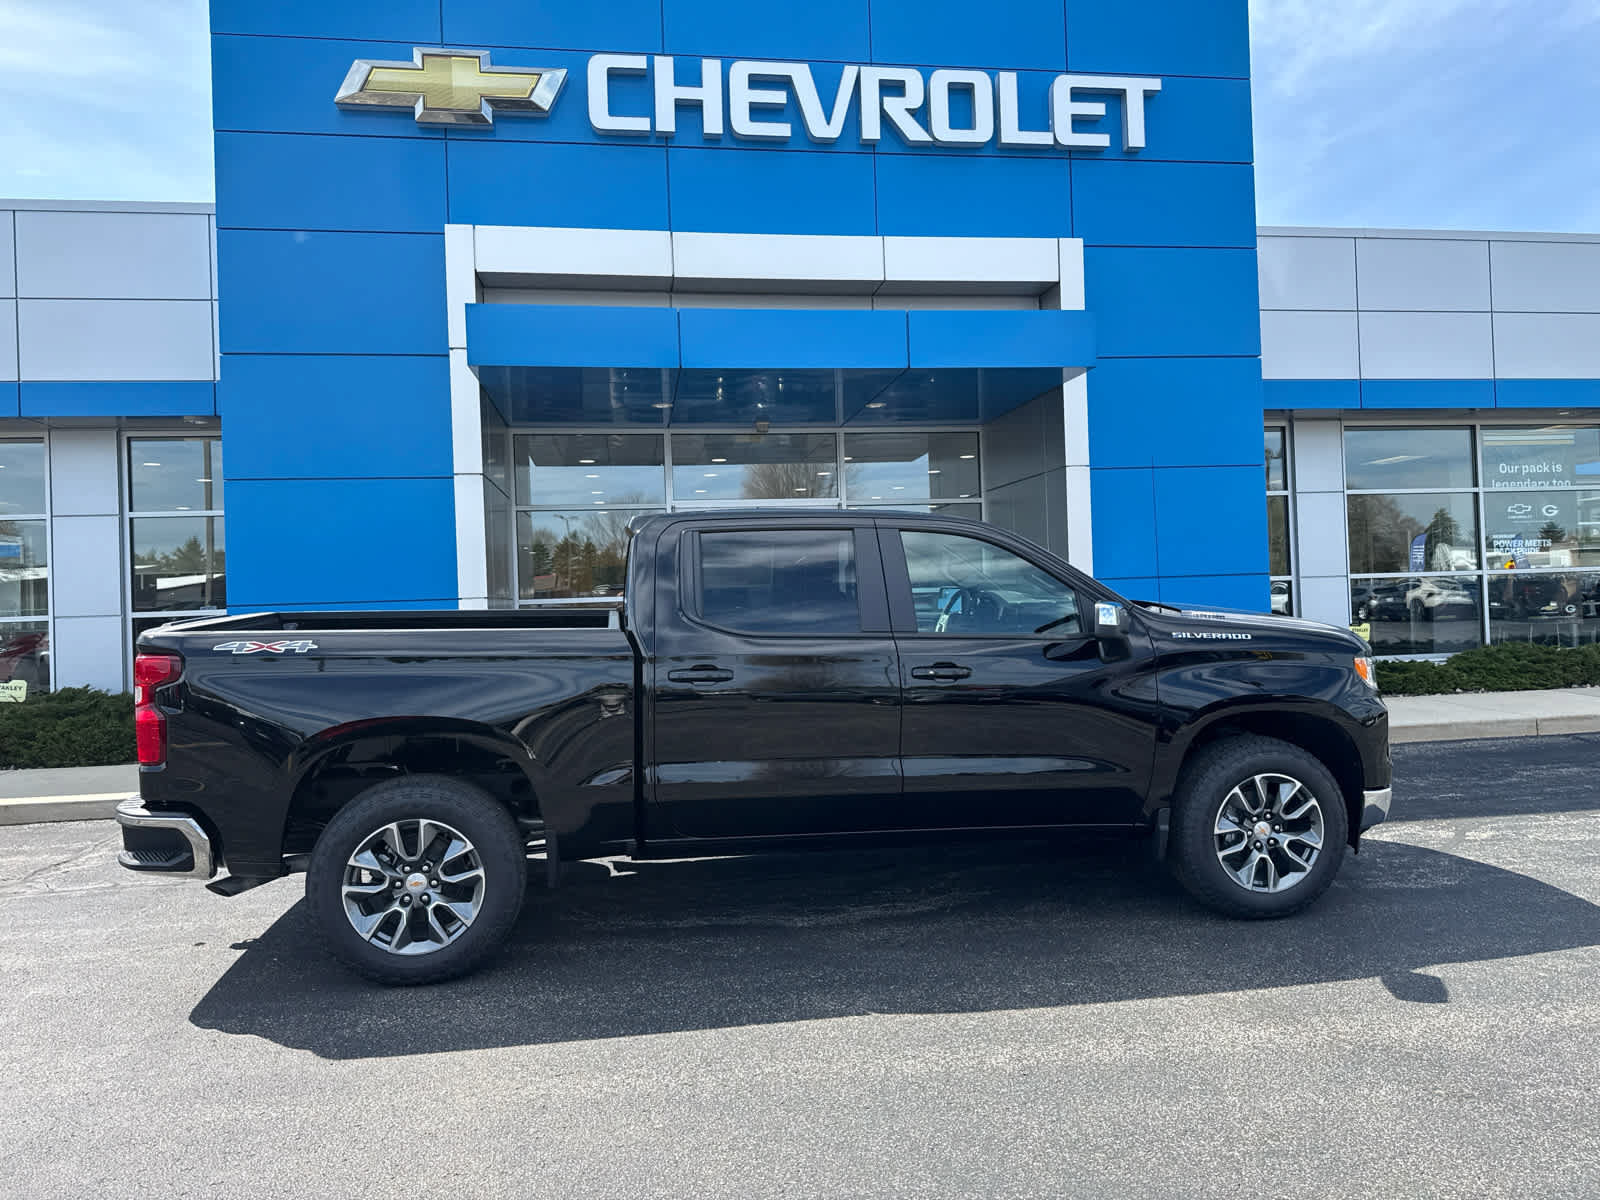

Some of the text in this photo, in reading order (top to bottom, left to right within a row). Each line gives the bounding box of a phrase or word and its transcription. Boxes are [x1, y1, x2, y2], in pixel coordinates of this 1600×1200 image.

[587, 53, 1163, 152] CHEVROLET
[1499, 462, 1563, 476] Our pack is
[1493, 538, 1552, 548] POWER MEETS
[1171, 631, 1252, 640] SILVERADO
